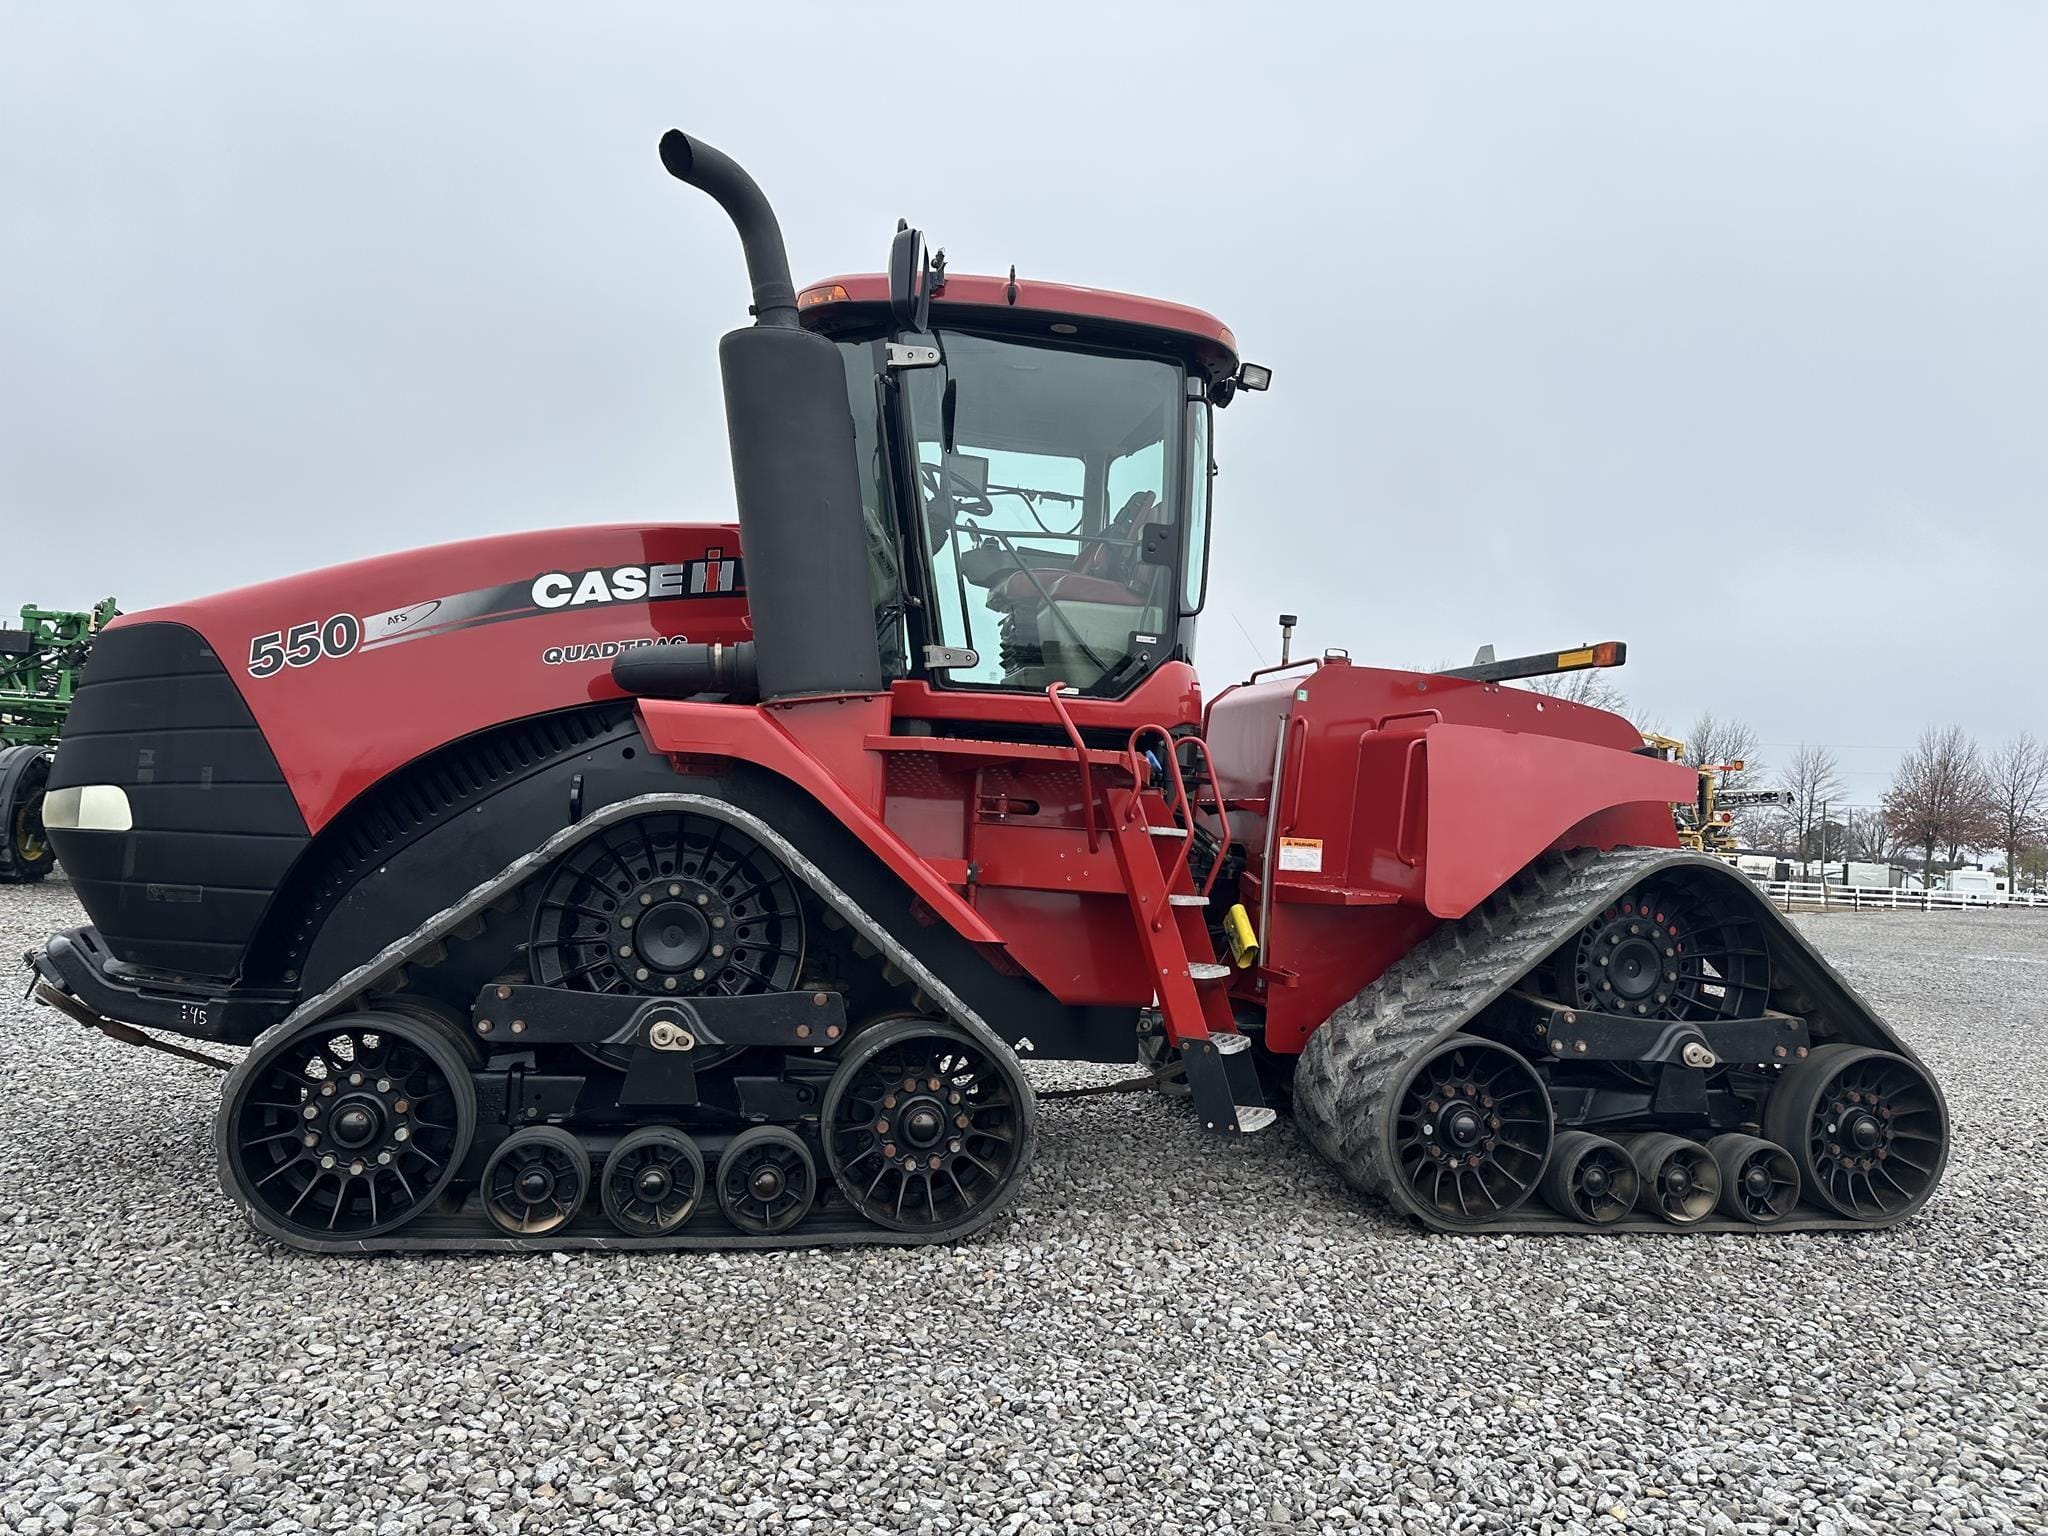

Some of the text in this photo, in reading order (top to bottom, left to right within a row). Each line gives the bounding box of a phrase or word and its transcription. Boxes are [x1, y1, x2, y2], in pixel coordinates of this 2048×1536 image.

[531, 564, 684, 608] CASE
[387, 613, 408, 625] AFS
[247, 613, 360, 679] 550
